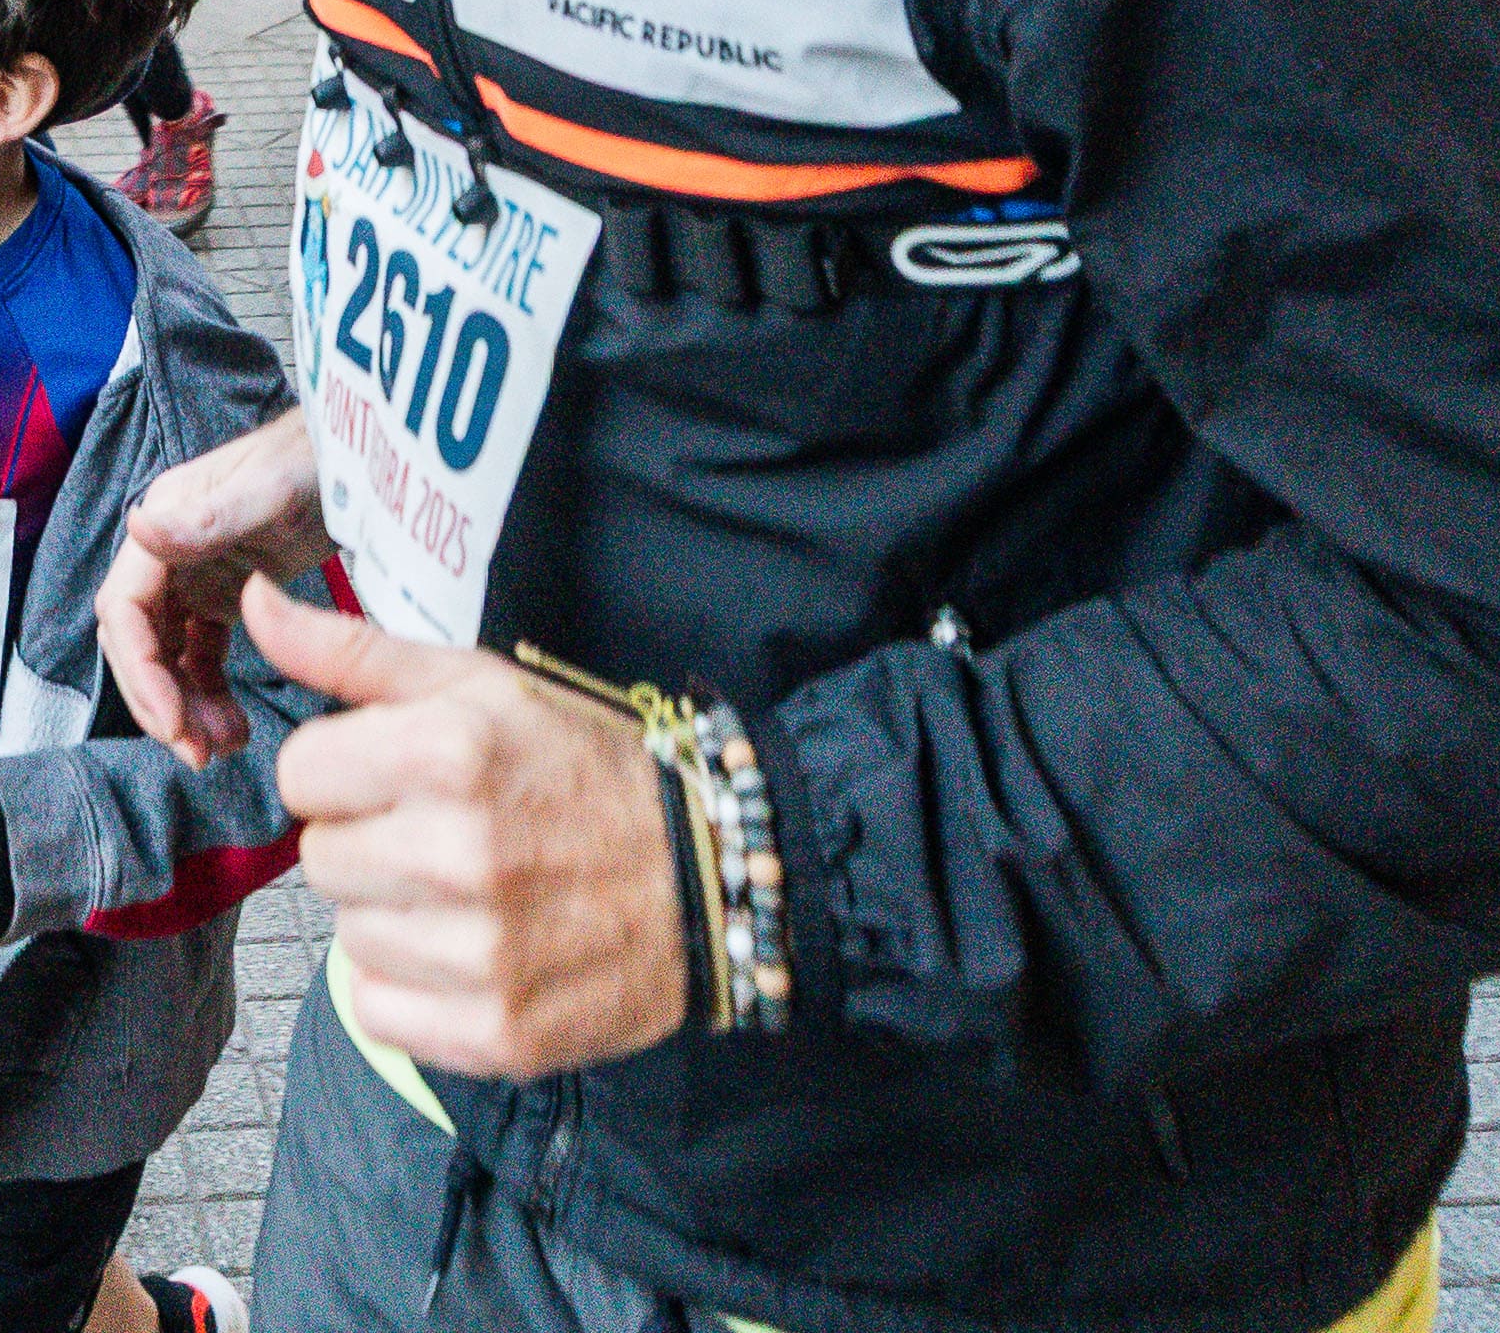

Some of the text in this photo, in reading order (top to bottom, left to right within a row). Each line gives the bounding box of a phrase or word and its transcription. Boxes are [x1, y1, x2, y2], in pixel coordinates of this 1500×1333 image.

[643, 19, 783, 74] REPUBLIC
[336, 215, 510, 474] 2610
[411, 475, 473, 578] 2025
